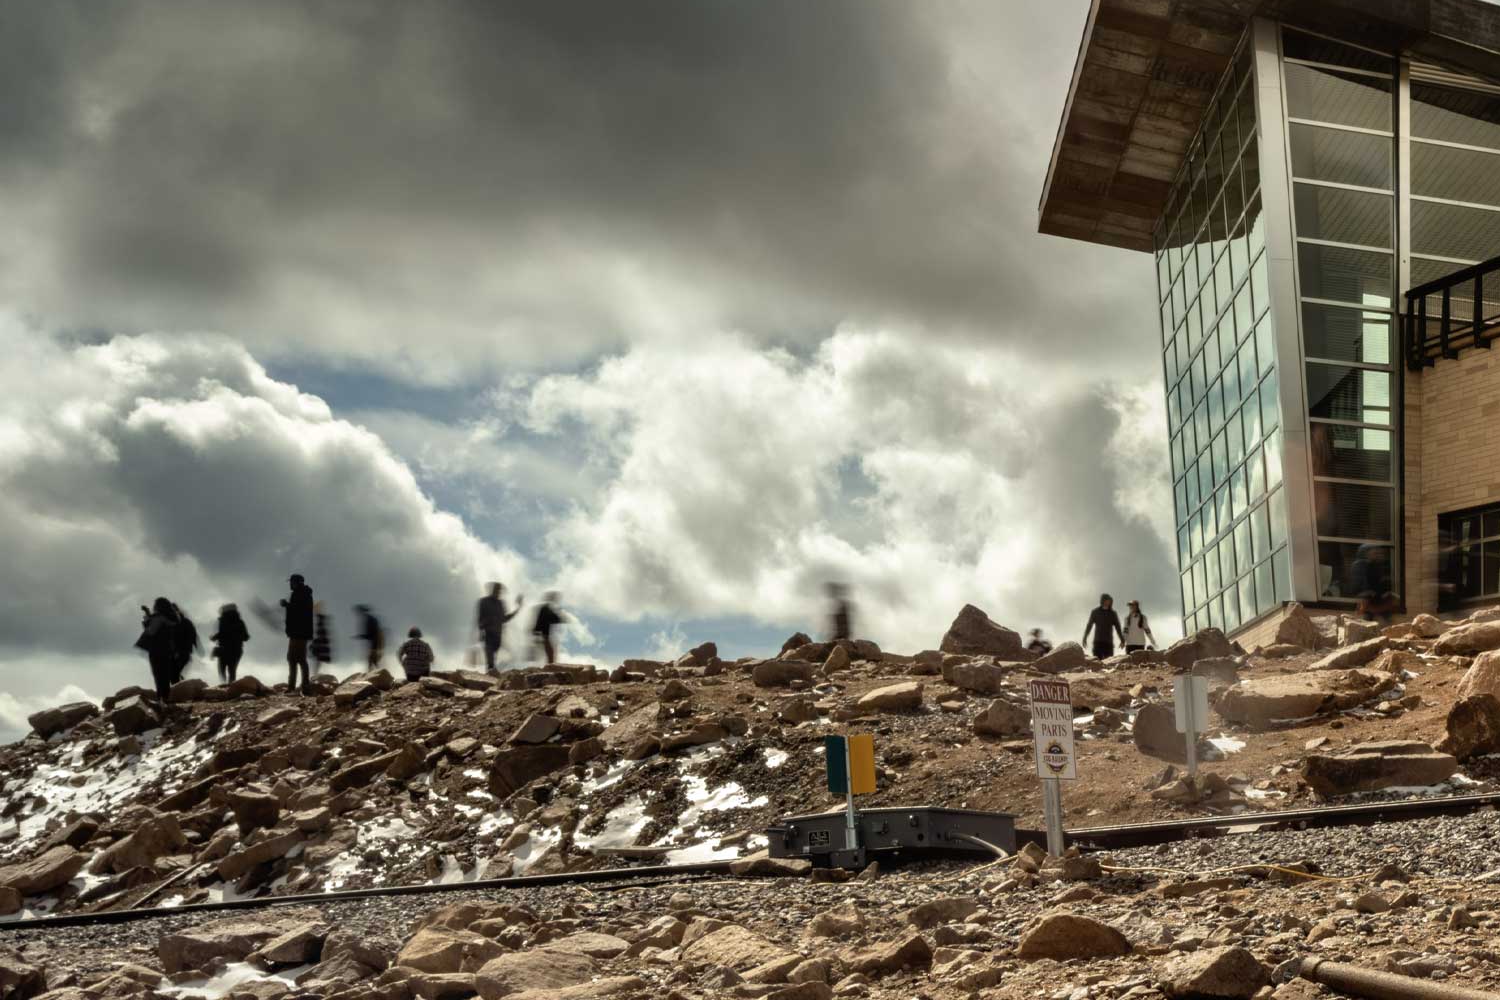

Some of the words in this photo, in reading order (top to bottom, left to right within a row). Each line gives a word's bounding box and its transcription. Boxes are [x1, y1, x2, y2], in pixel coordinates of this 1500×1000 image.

[1032, 684, 1069, 702] DANGER
[1035, 706, 1070, 721] MOVING
[1041, 723, 1067, 737] PARTS
